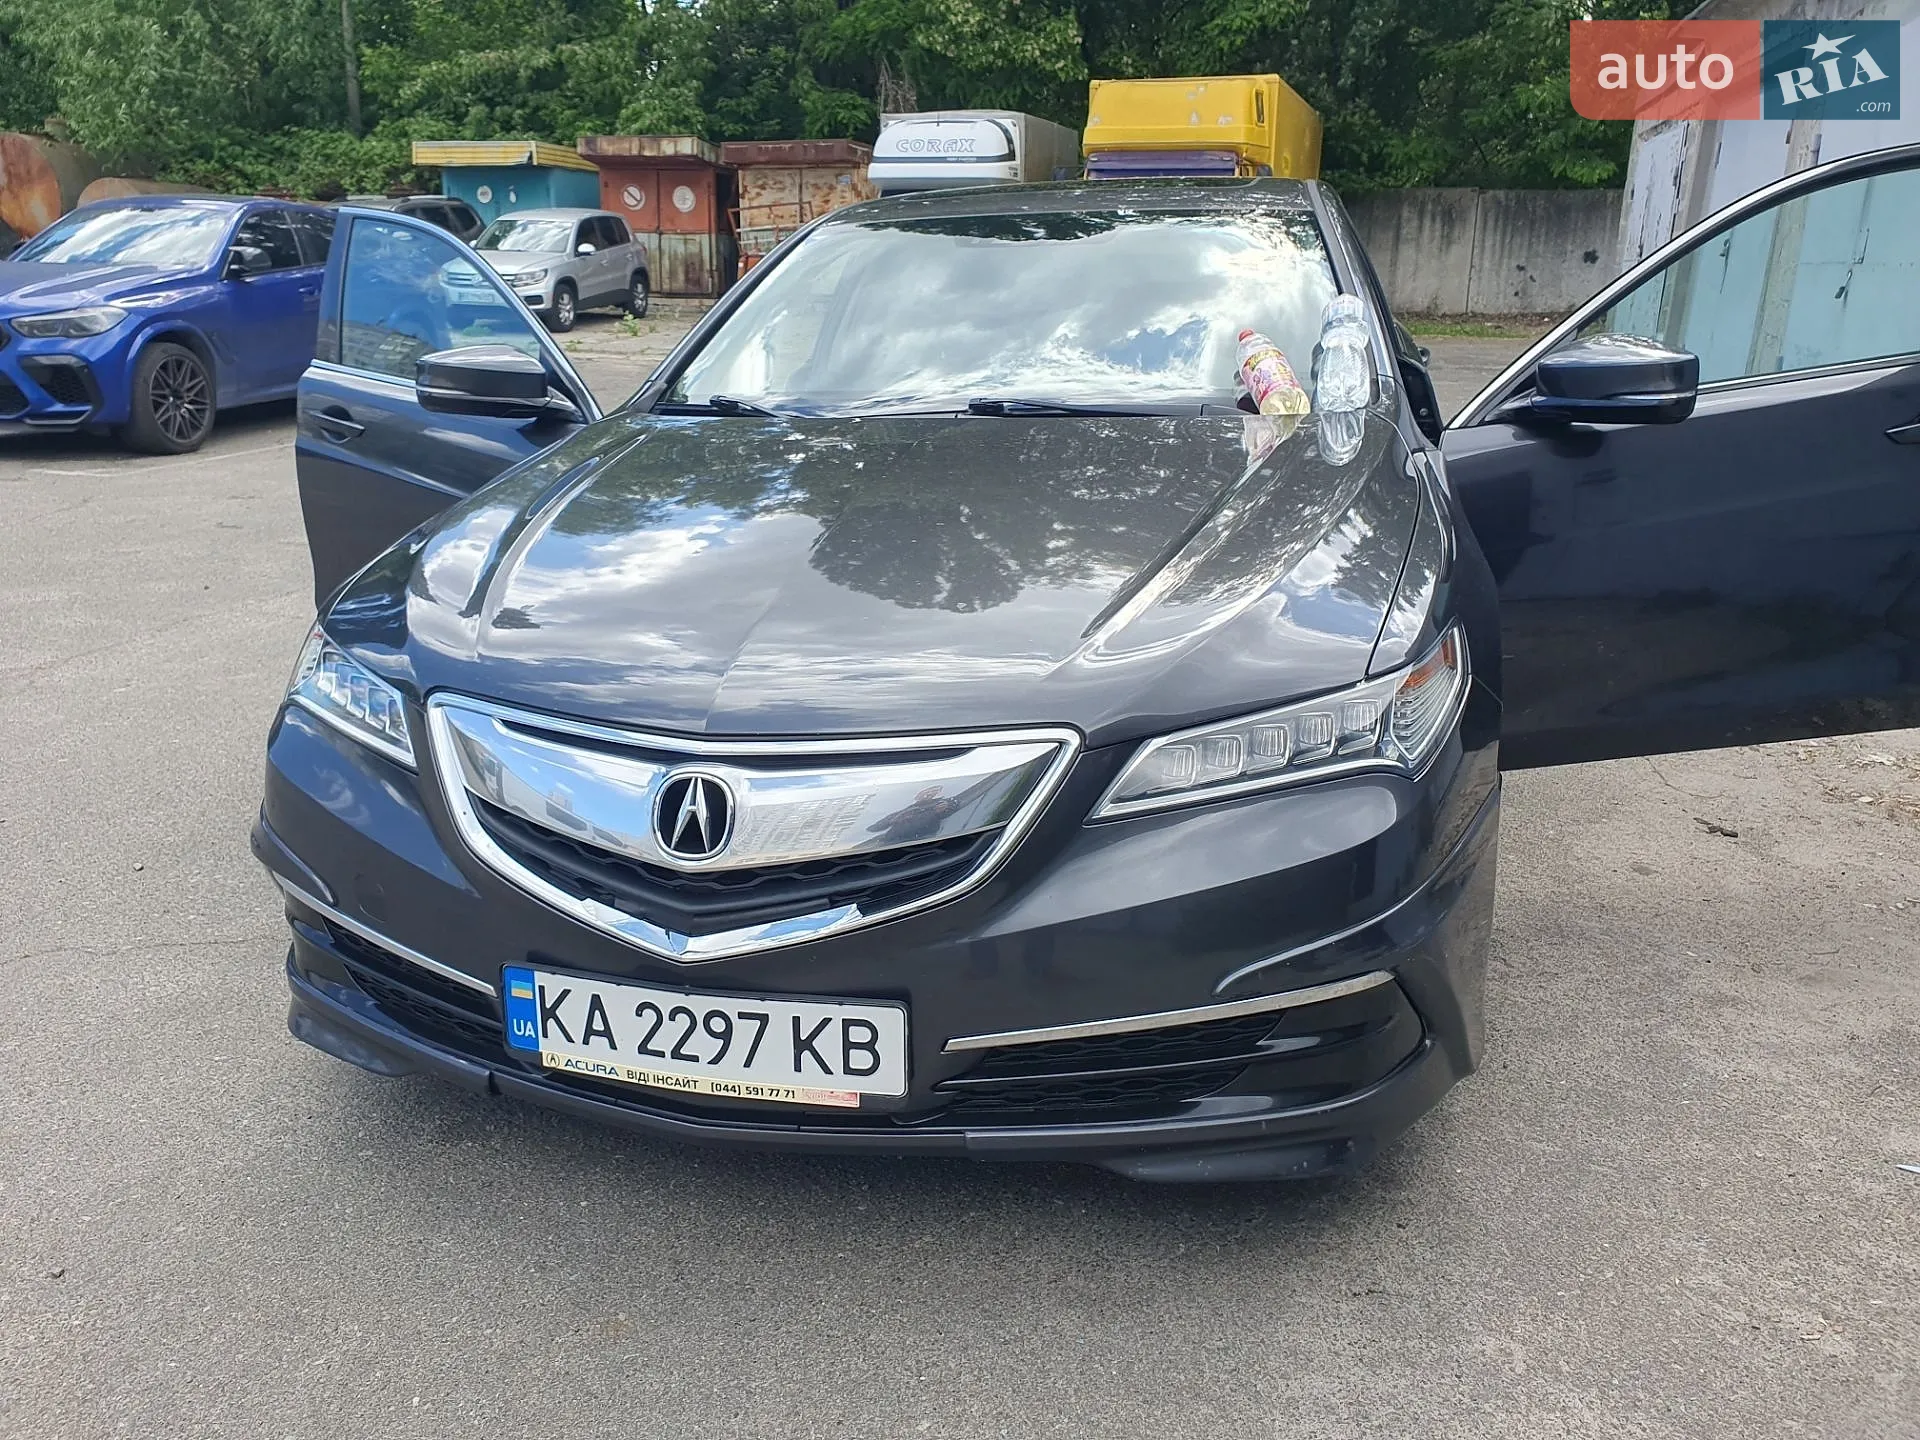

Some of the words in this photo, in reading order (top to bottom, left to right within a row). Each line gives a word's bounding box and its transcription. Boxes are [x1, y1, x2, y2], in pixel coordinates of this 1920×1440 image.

[896, 138, 976, 153] CORAX
[513, 1018, 536, 1038] UA
[538, 985, 618, 1051] KA
[635, 1001, 770, 1068] 2297
[790, 1015, 882, 1077] KB
[564, 1058, 619, 1076] ACURA
[627, 1069, 650, 1083] ВІДІ
[653, 1075, 699, 1090] ІНСАЙТ
[745, 1086, 764, 1097] 591
[768, 1088, 781, 1098] 77
[783, 1090, 796, 1099] 71
